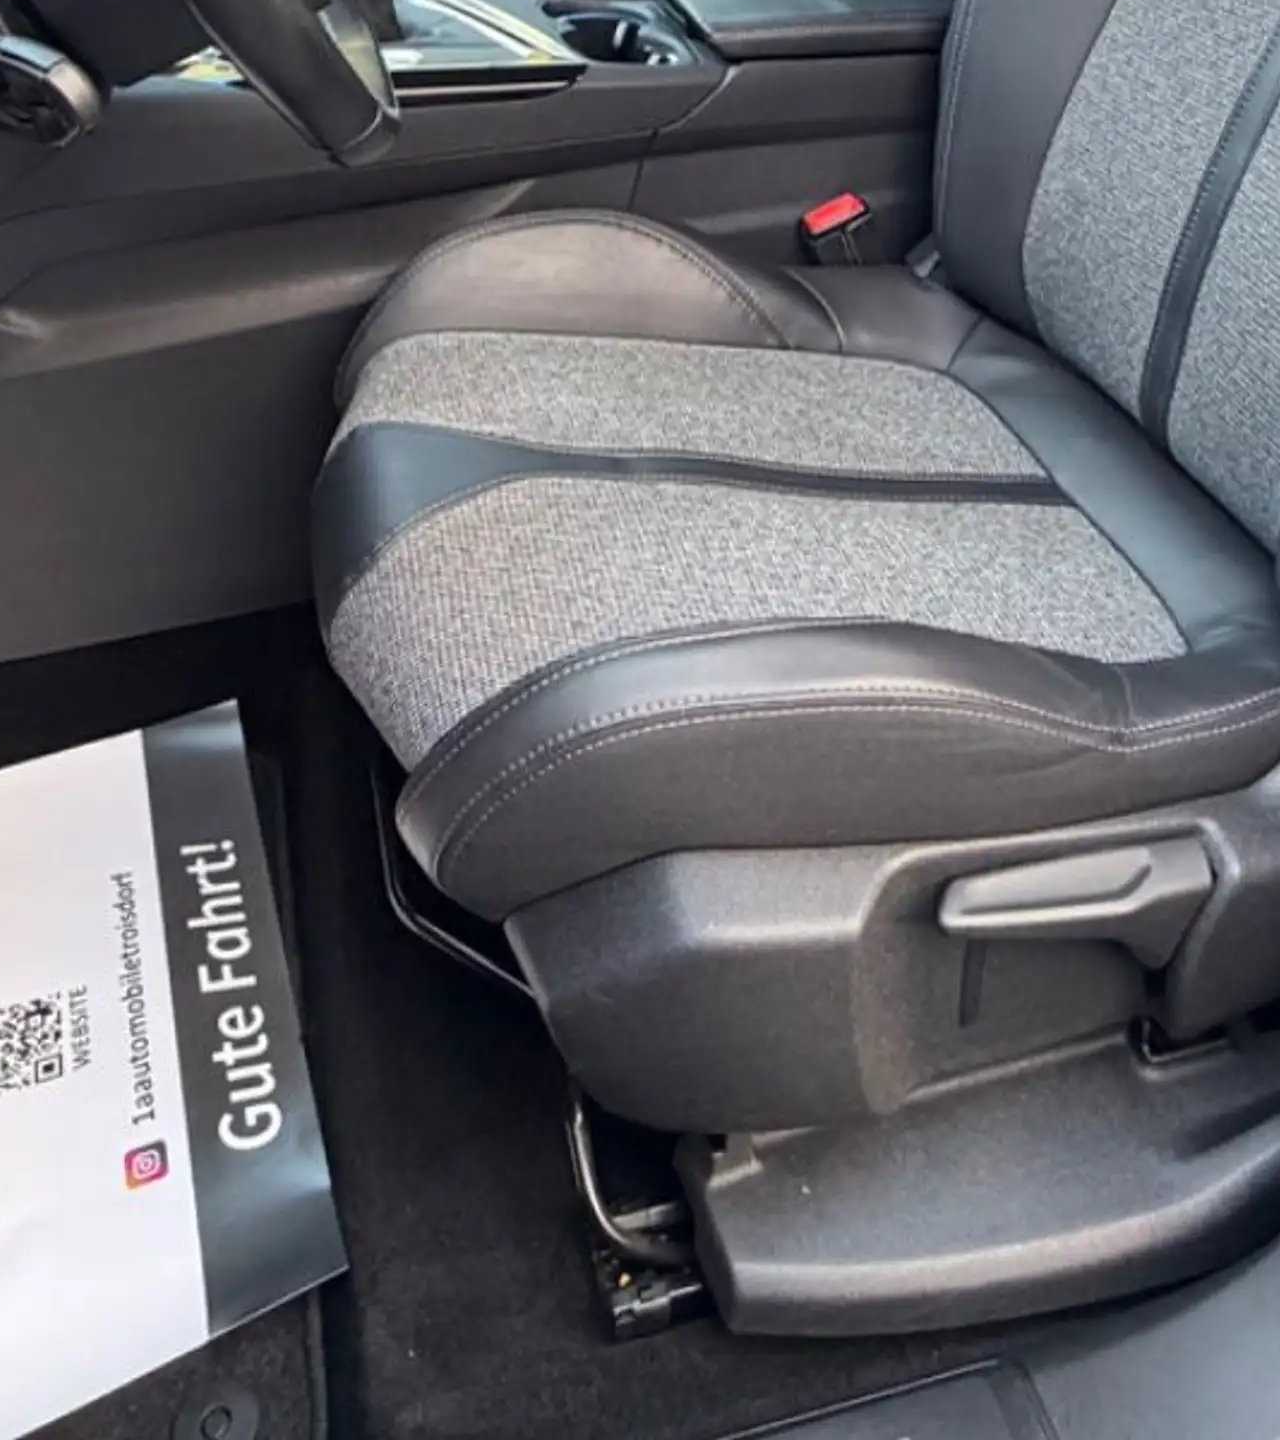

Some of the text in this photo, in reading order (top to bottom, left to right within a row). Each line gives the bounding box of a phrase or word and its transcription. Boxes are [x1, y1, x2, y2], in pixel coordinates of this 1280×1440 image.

[67, 984, 93, 1073] WEBSITE
[109, 871, 157, 1126] 1aautomobiletroisdorf
[180, 839, 283, 1151] Gute Fahrt!
